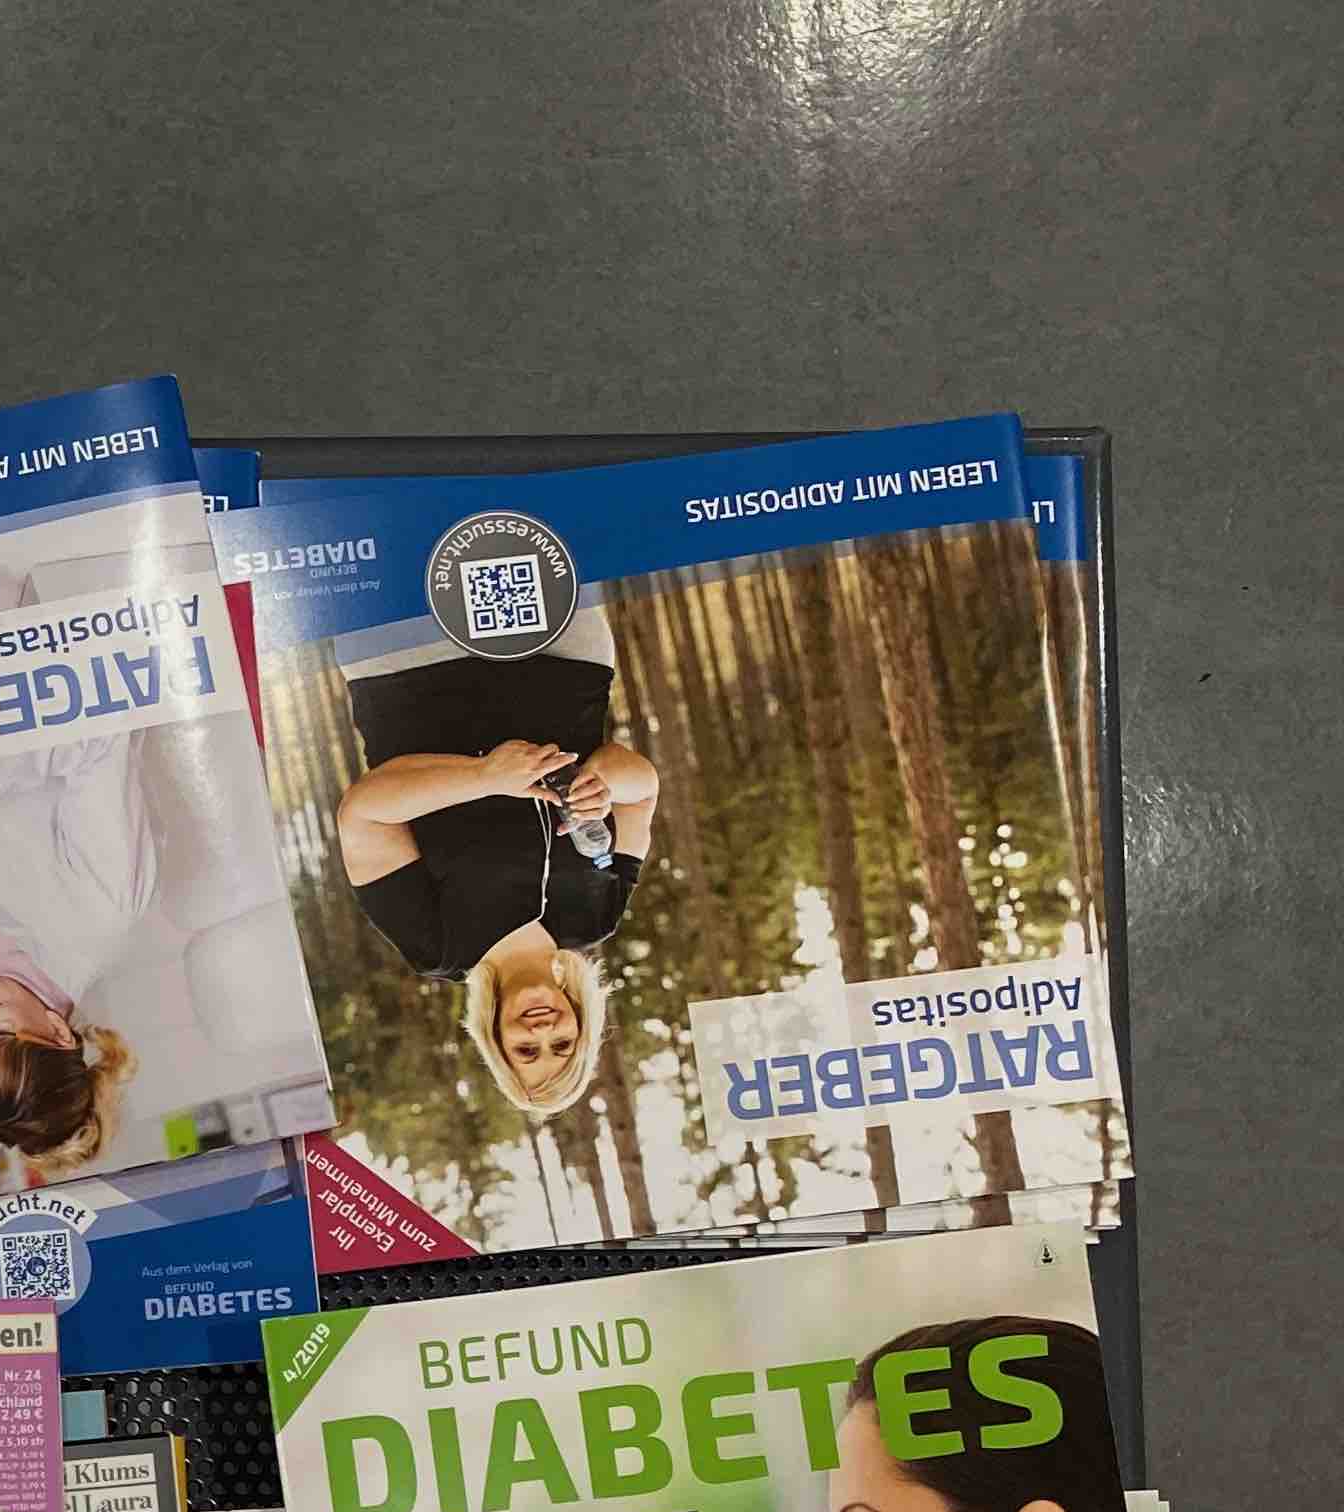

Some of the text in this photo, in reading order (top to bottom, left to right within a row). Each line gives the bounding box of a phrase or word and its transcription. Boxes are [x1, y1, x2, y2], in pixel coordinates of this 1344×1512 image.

[17, 446, 66, 476] MIT
[73, 426, 159, 462] LEBEN
[685, 460, 998, 523] LEBEN MIT ADIPOSITAS
[435, 519, 567, 590] www.esssucht.net
[872, 976, 1081, 1027] Adipositas
[722, 1020, 1093, 1121] RATGEBER
[144, 1288, 293, 1321] DIABETES
[165, 1282, 214, 1294] BEFUND
[282, 1322, 331, 1385] 4/2019
[419, 1318, 653, 1390] BEFUND
